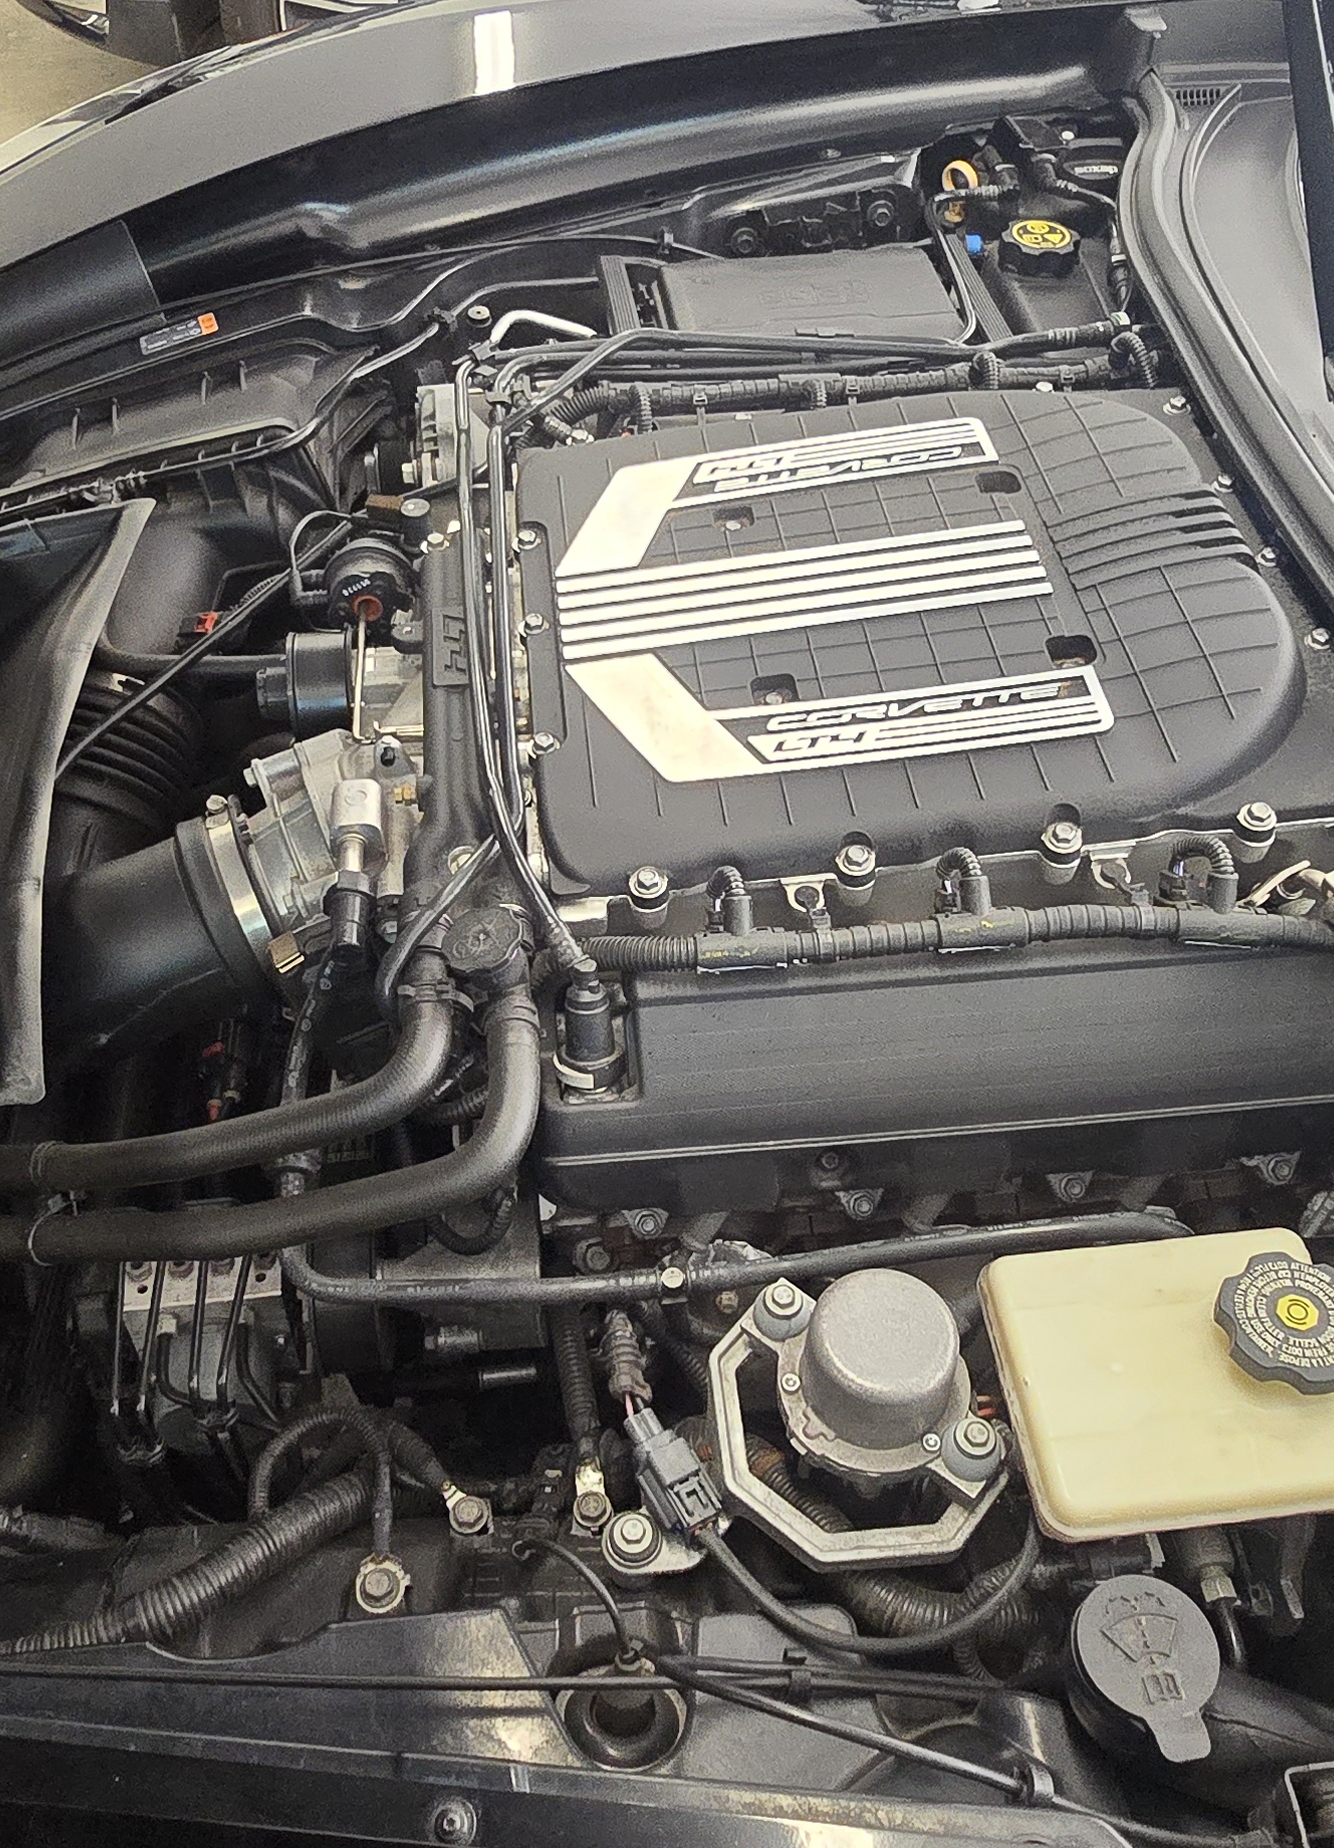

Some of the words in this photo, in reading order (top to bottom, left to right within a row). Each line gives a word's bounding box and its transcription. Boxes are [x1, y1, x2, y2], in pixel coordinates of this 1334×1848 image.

[713, 446, 963, 493] CORVETTE
[766, 684, 1060, 731] CORVETTE
[773, 730, 867, 753] LT4
